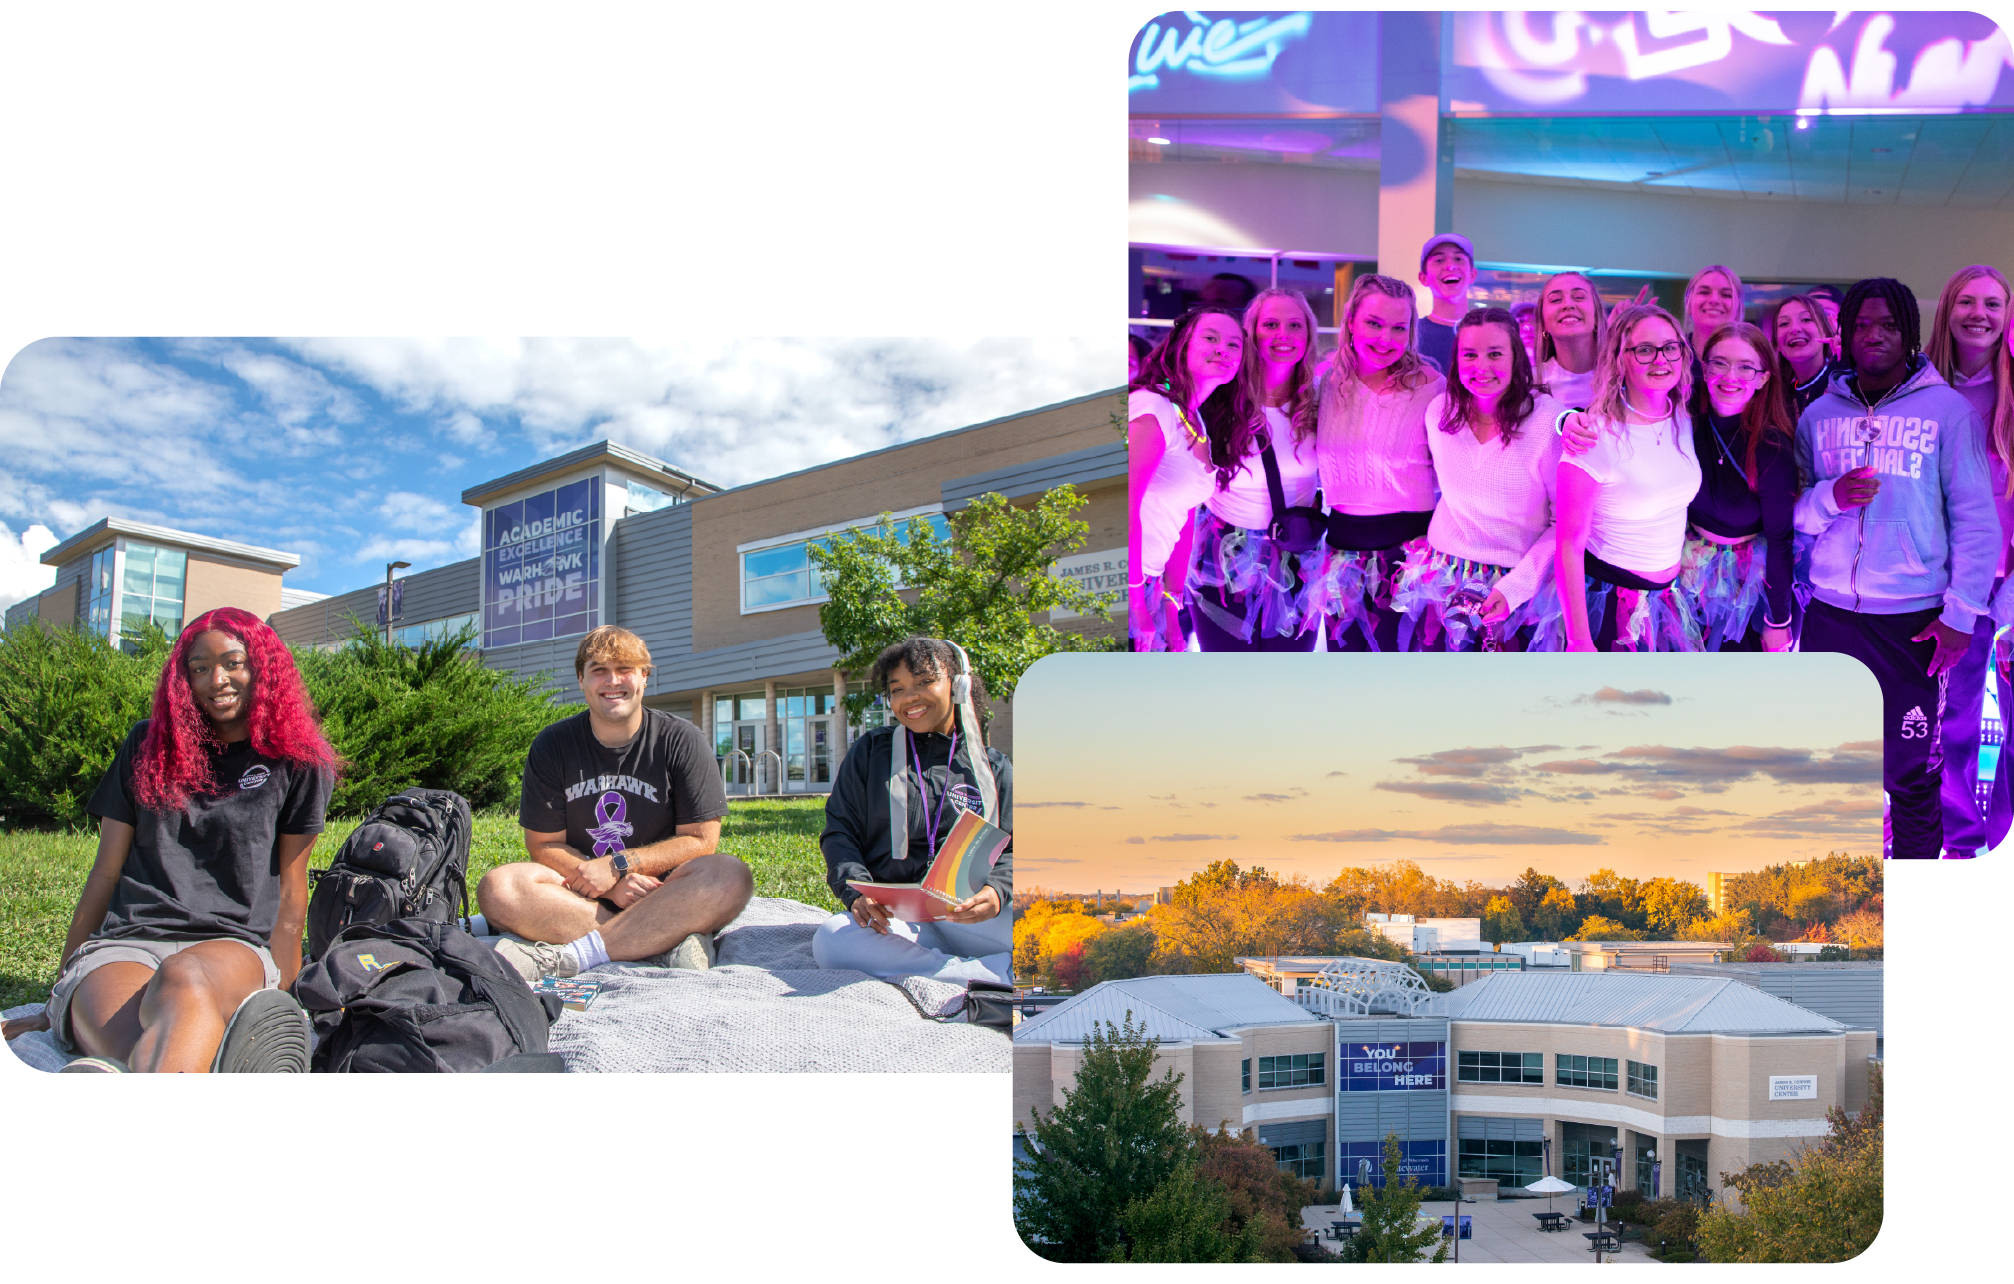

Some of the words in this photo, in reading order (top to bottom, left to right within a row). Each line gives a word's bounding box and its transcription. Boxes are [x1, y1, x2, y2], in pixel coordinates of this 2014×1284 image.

[499, 509, 584, 546] ACADEMIC
[499, 527, 583, 562] EXCELLENCE
[499, 552, 583, 586] WARHWK
[1060, 563, 1100, 578] JAMES
[1103, 561, 1116, 571] R.
[1066, 572, 1128, 593] NIVER
[498, 571, 583, 615] PRIDE
[1900, 720, 1929, 739] 53
[565, 775, 660, 803] WARHAWK
[947, 790, 982, 806] UNIVERSIT
[1365, 1048, 1397, 1060] YOU
[1353, 1061, 1414, 1073] BELONG
[1394, 1074, 1433, 1086] HERE
[1381, 1164, 1429, 1172] tewater
